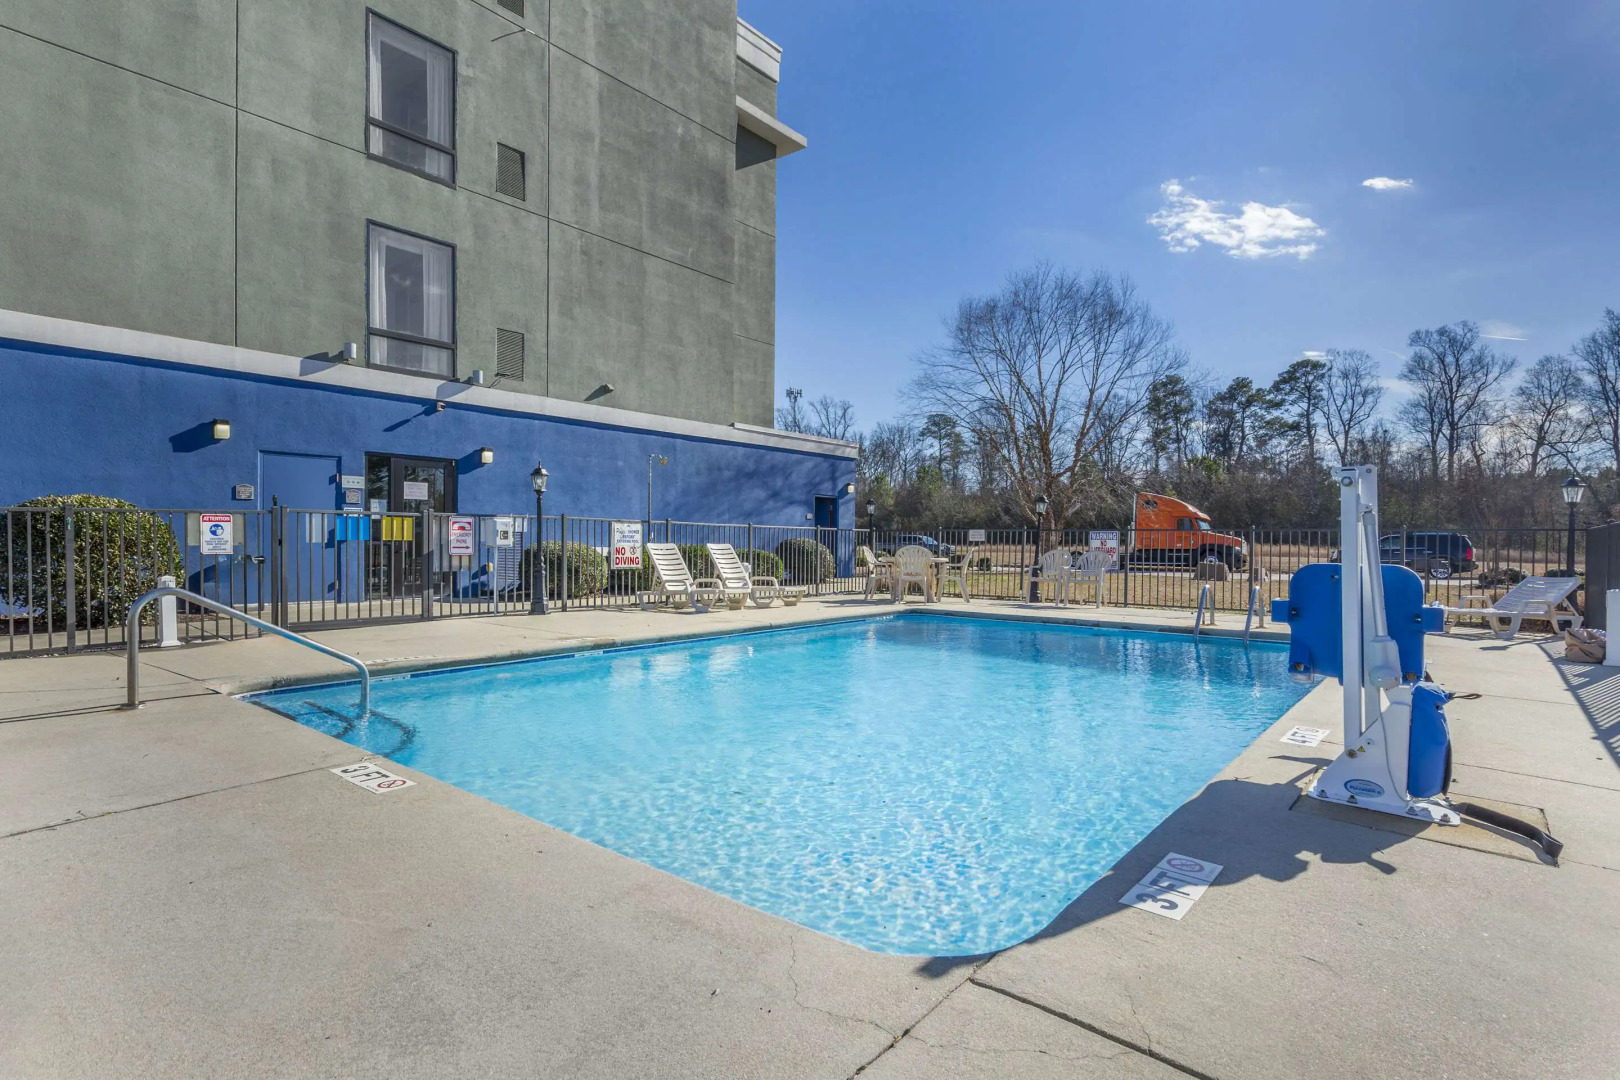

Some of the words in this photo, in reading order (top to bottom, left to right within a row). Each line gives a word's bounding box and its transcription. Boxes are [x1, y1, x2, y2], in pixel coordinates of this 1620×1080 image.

[615, 547, 626, 555] NO
[615, 557, 639, 565] DIVING
[341, 765, 369, 773] 3
[351, 771, 391, 782] FT
[1149, 870, 1199, 897] FT
[1135, 892, 1178, 910] 3
